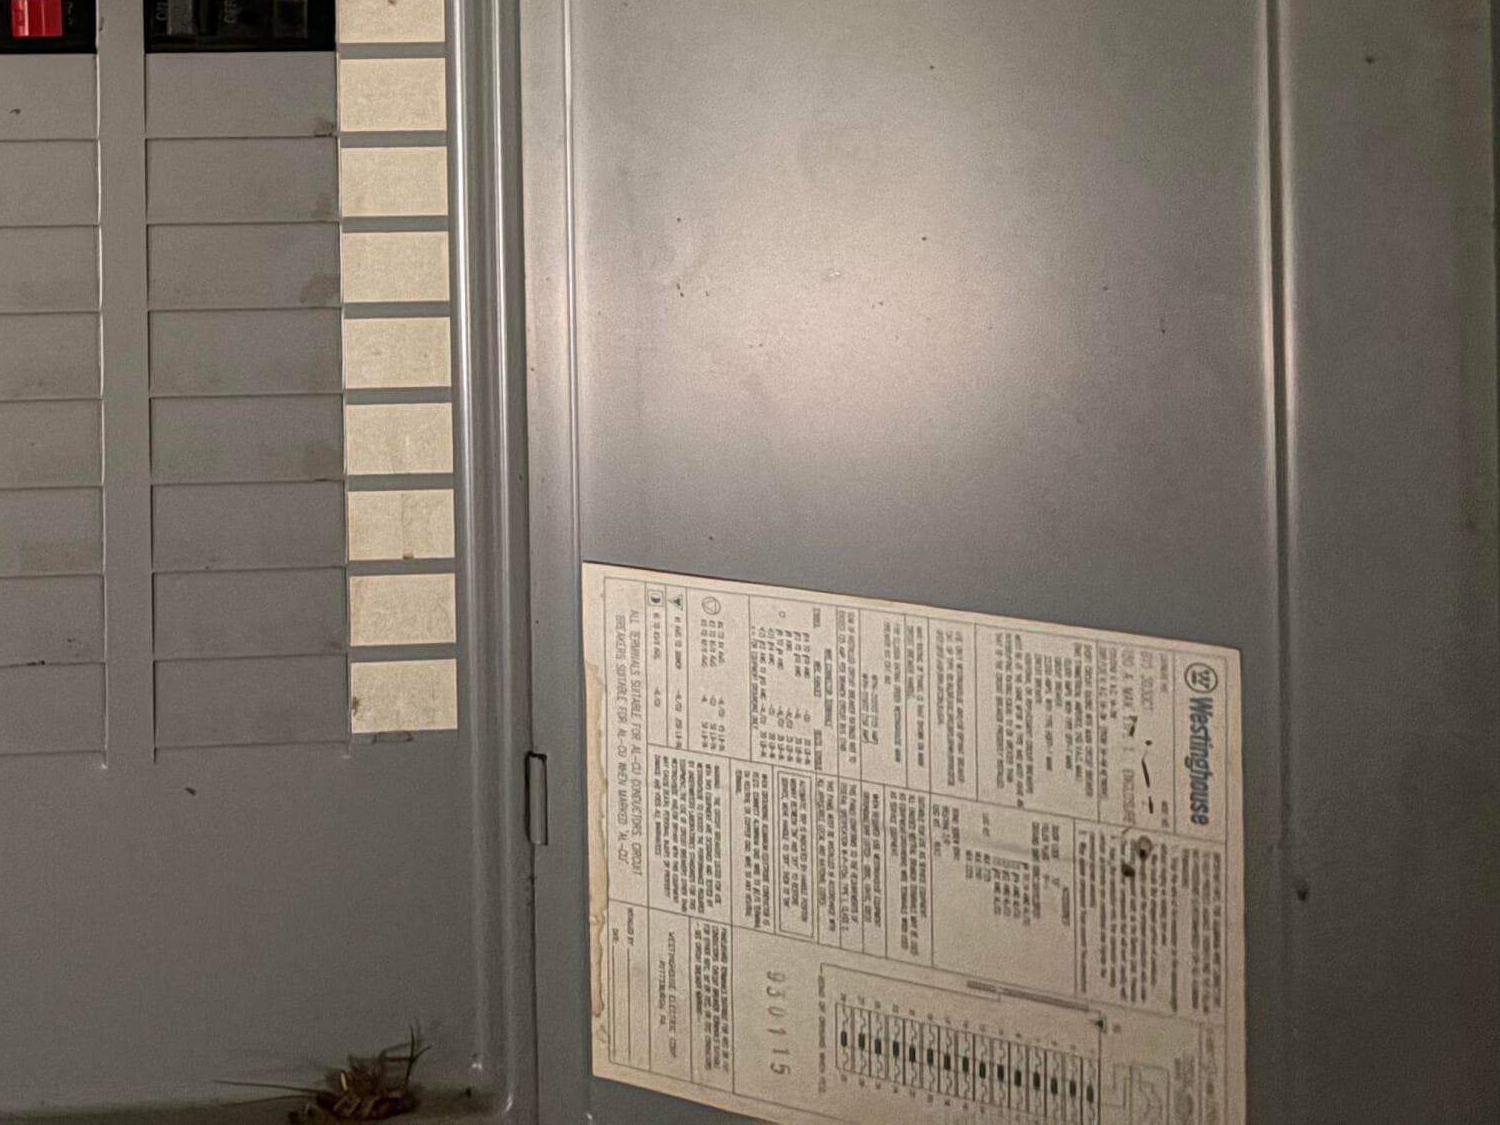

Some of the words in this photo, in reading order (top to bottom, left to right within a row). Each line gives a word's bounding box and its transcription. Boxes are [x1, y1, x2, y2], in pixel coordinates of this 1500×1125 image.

[617, 706, 628, 723] FOR
[631, 723, 642, 741] FOR
[1185, 697, 1214, 825] Westinghouse
[631, 842, 642, 876] CIRCUIT
